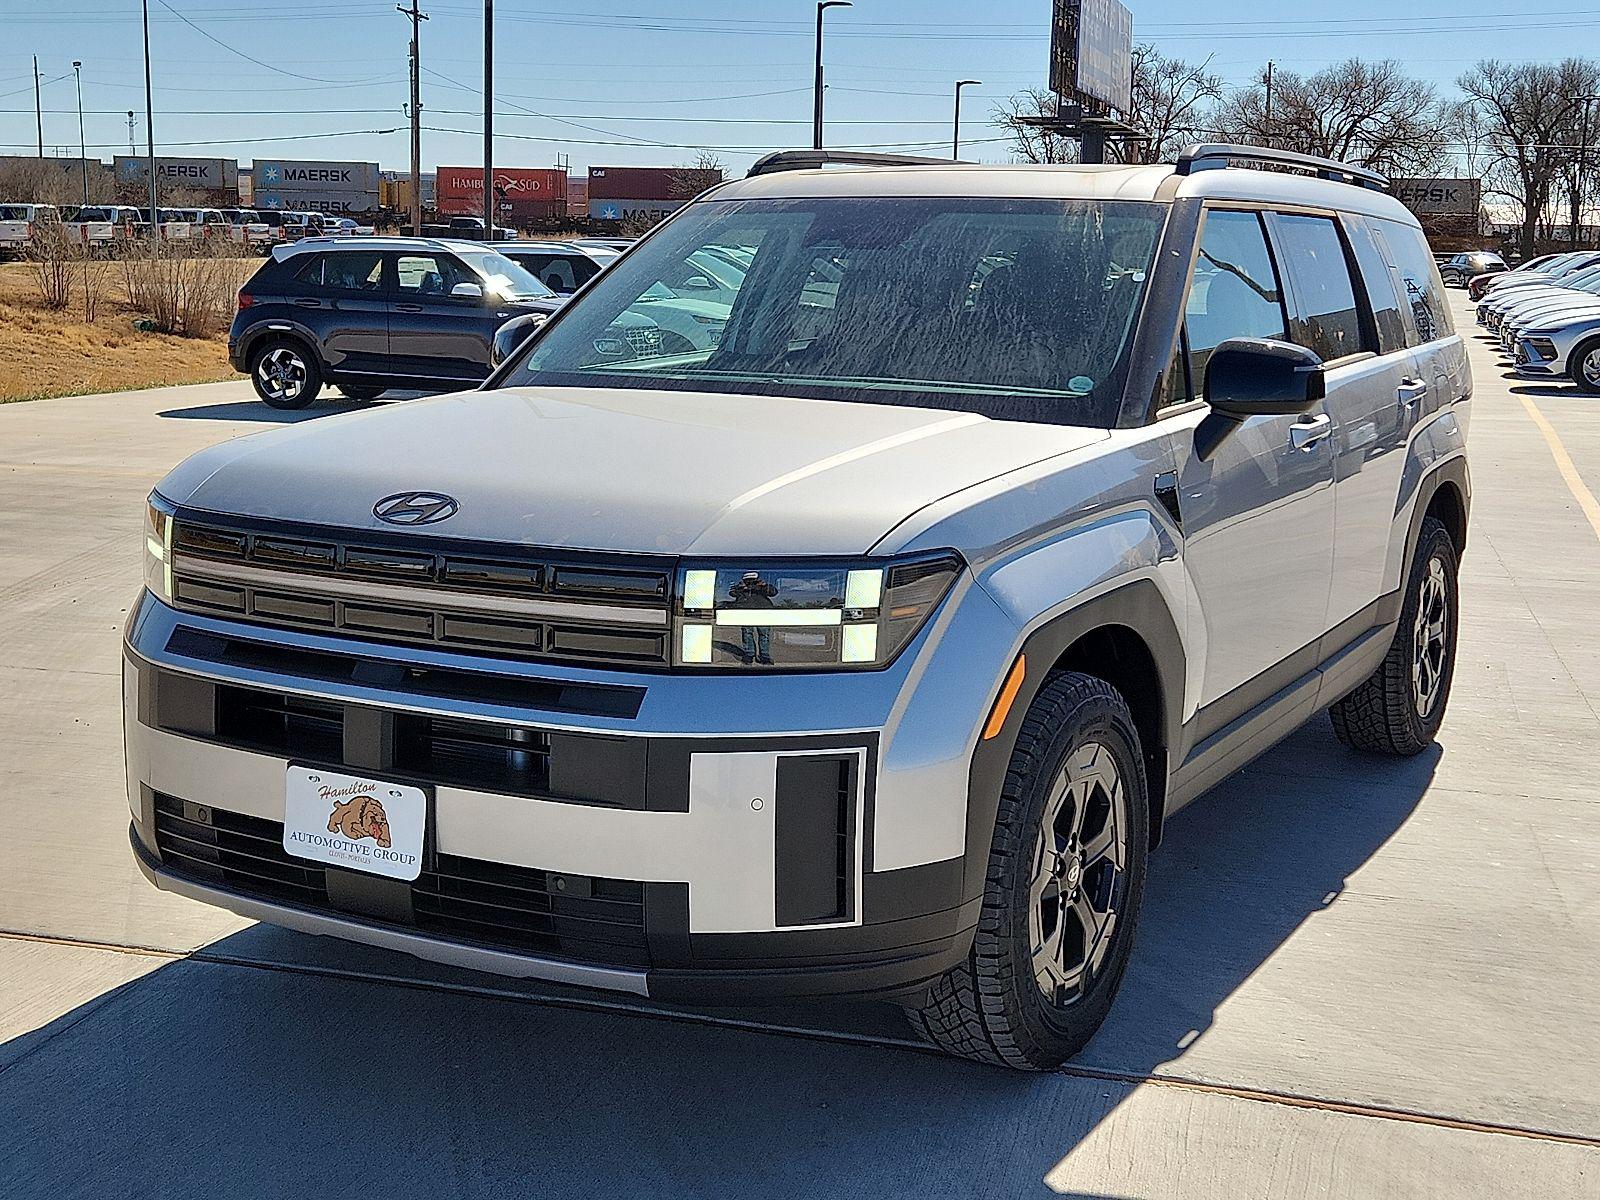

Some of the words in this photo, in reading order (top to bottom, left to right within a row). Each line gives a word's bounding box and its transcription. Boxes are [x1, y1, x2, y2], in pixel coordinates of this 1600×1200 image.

[145, 165, 208, 178] AERSK
[284, 168, 351, 182] MAERSK
[452, 178, 501, 189] HAMBG
[519, 178, 540, 190] SÜD
[1401, 188, 1458, 202] ERSK
[622, 208, 671, 220] MAER
[318, 781, 377, 799] Hamilton
[290, 831, 370, 856] AUTOMOTIVE
[373, 848, 416, 865] GROUP
